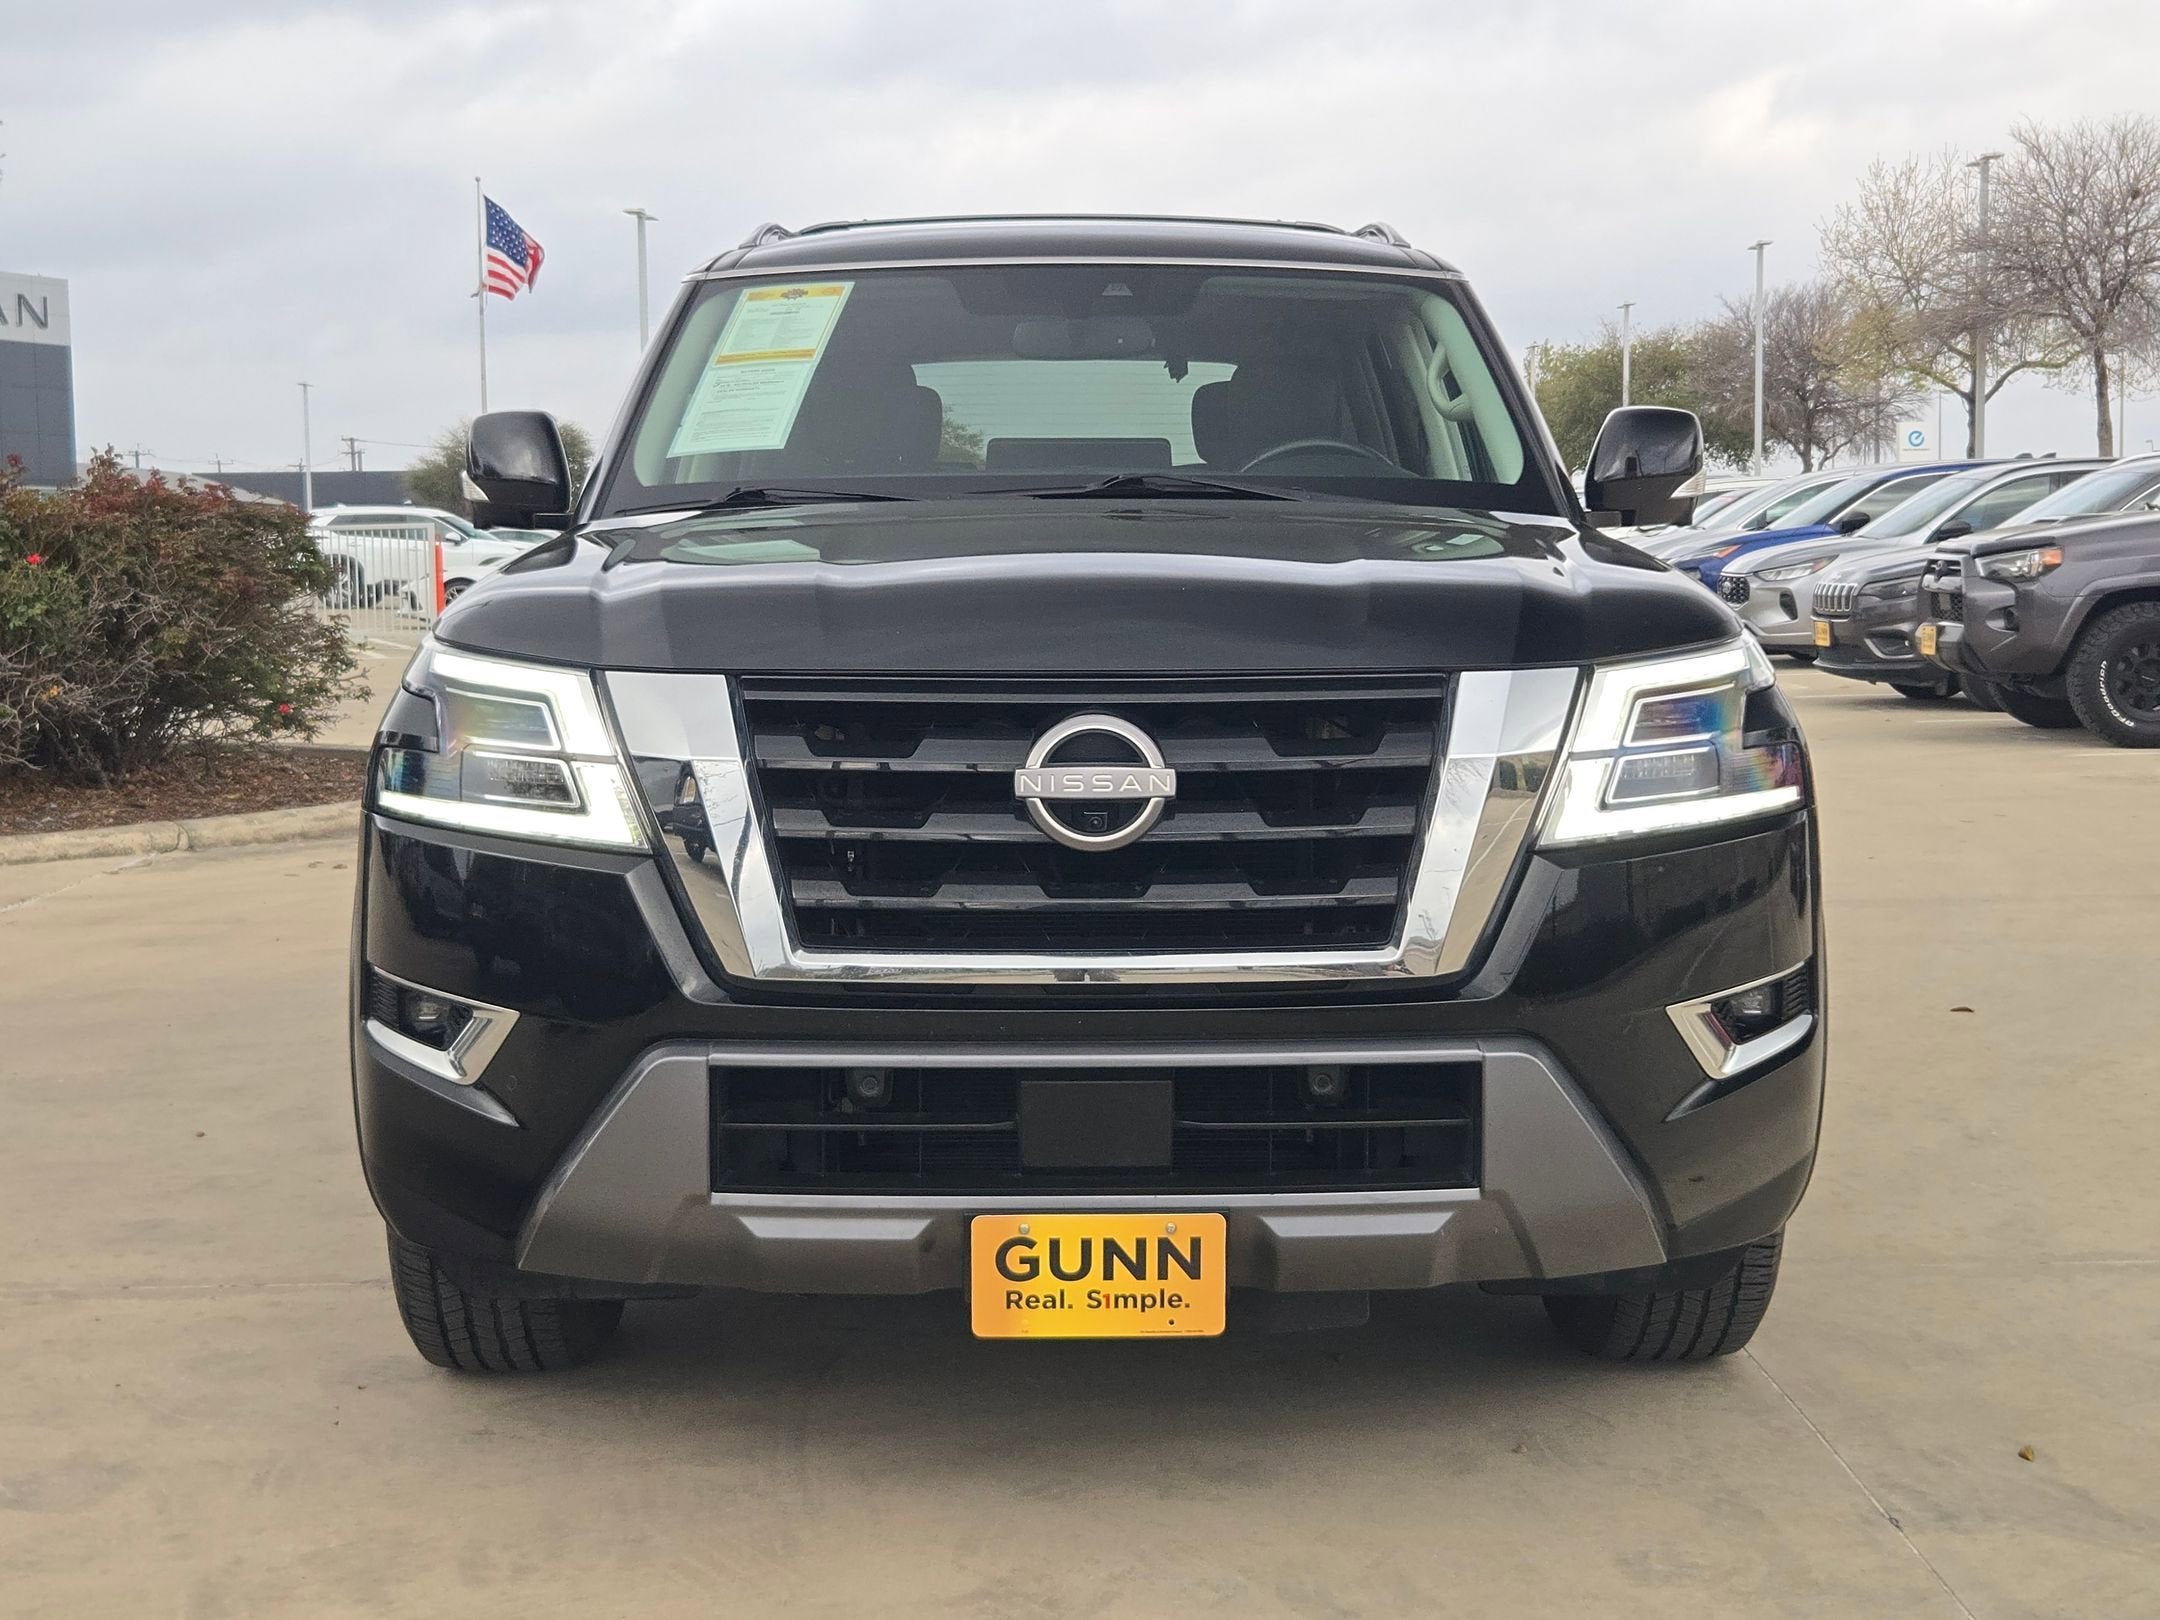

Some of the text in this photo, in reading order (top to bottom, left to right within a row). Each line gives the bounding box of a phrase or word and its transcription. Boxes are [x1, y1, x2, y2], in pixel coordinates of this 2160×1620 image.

[0, 293, 48, 330] N
[1020, 773, 1171, 793] NISSAN
[994, 1236, 1202, 1282] GUNN
[1005, 1289, 1191, 1312] Real. S1mple.
